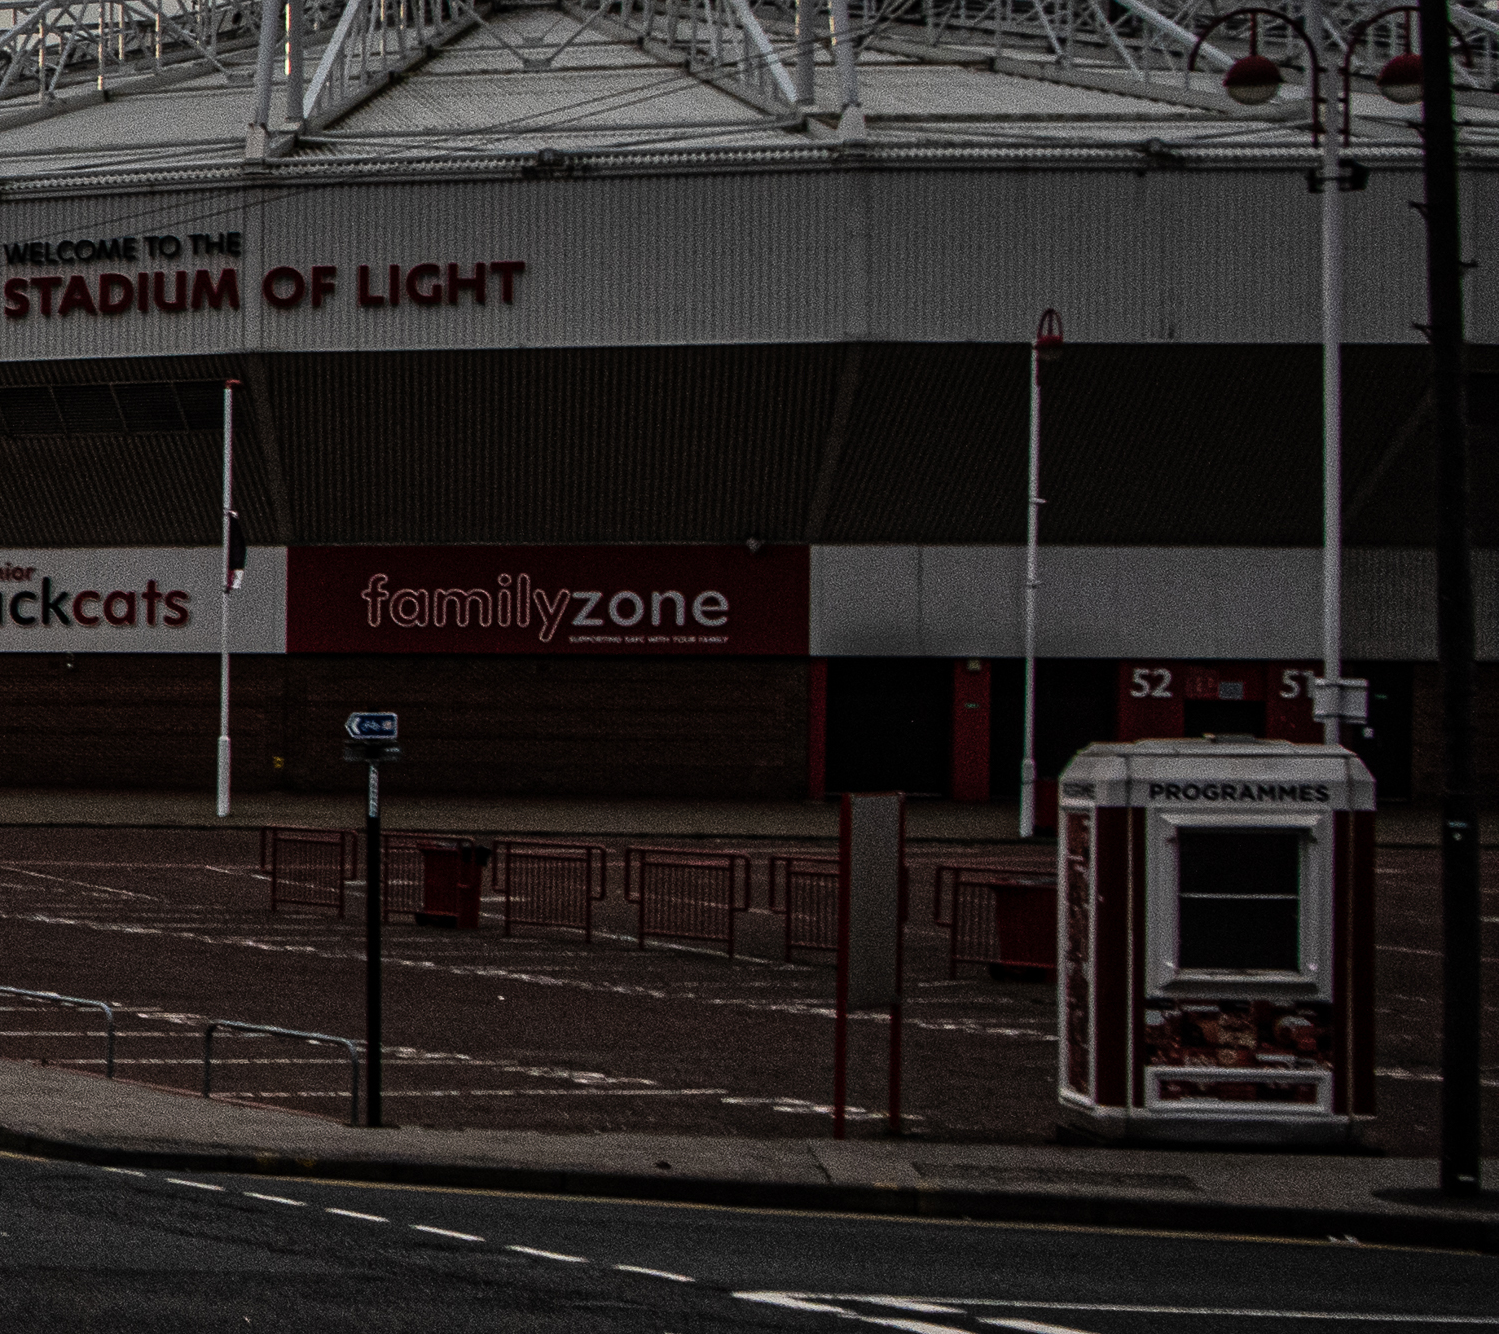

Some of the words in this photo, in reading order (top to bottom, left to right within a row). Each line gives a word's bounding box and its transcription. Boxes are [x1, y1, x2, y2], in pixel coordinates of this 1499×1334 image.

[4, 238, 137, 265] WELCOME
[145, 236, 181, 259] TO
[189, 232, 241, 256] THE
[5, 269, 239, 318] STADIUM
[263, 266, 336, 307] OF
[359, 261, 524, 306] LIGHT
[361, 573, 730, 643] familyzone
[1130, 668, 1173, 699] 52
[1149, 783, 1330, 802] PROGRAMMES
